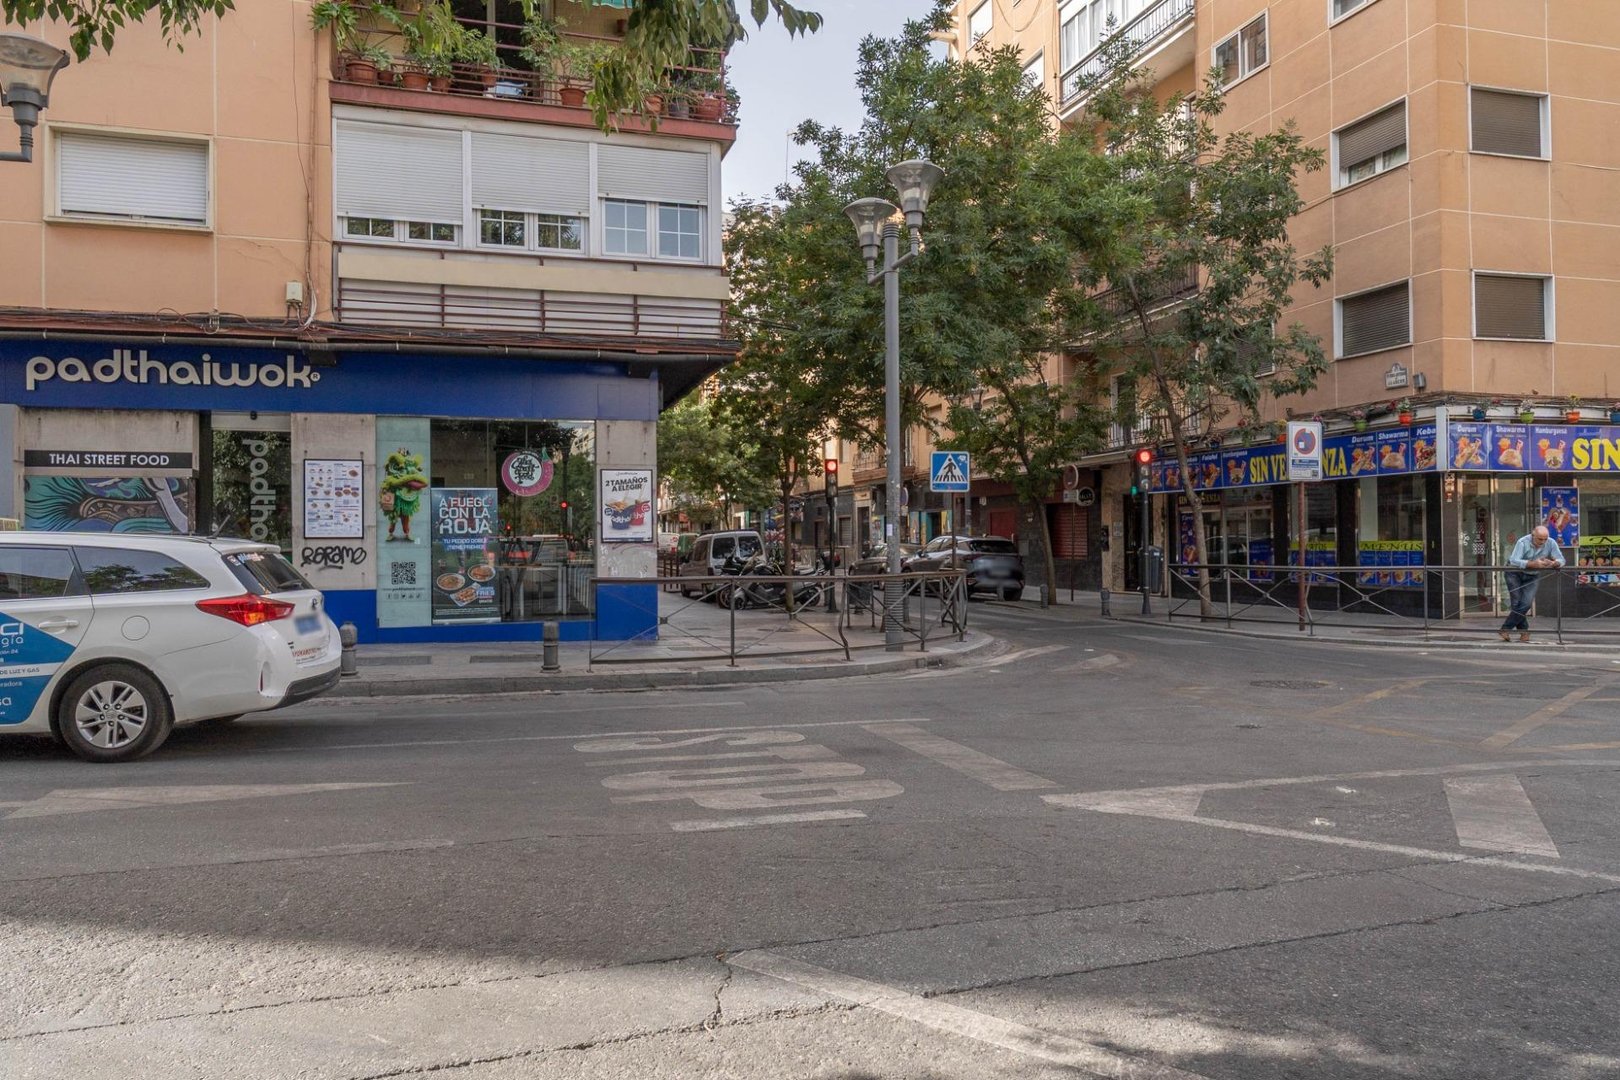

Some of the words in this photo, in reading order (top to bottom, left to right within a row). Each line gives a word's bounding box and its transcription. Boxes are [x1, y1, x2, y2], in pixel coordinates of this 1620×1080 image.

[1416, 426, 1436, 436] Keba
[49, 454, 80, 465] THAI
[84, 454, 126, 465] STREET
[130, 455, 169, 466] FOOD
[1249, 455, 1269, 483] SIN
[611, 476, 648, 486] TAMAÑOS
[439, 497, 448, 507] A
[439, 507, 469, 518] CON
[473, 507, 490, 518] LA
[439, 518, 493, 534] ROJA
